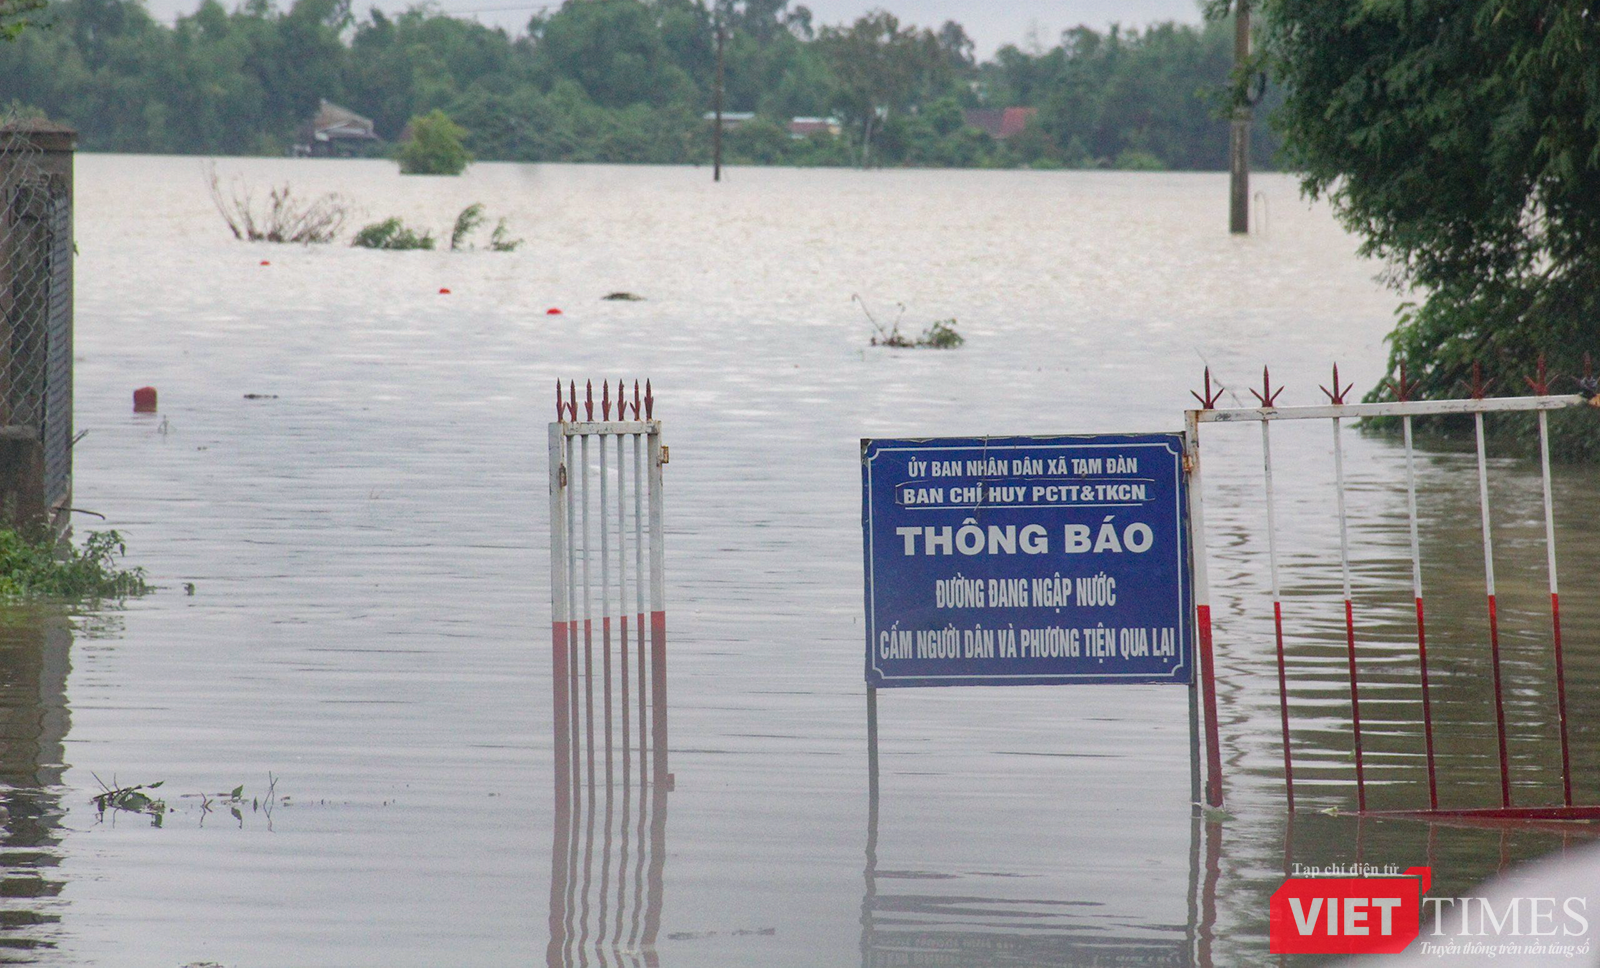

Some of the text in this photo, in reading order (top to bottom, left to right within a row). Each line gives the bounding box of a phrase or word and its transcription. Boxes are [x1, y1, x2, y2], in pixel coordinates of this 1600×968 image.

[908, 457, 926, 477] ỦY
[932, 461, 962, 476] BAN
[967, 457, 1008, 476] NHÂN
[1013, 457, 1043, 475] DÂN
[1048, 456, 1067, 475] XÃ
[1106, 455, 1137, 474] ĐÀN
[903, 482, 1146, 503] BAN CHỈ HUY PCTT&TKCN
[896, 515, 1153, 555] THÔNG BÁO
[936, 571, 1116, 612] ĐƯỜNG ĐANG NGẬP NƯỚC
[880, 621, 1174, 663] CẤM NGƯỜI DÂN VÀ PHƯƠNG TIỆN QUA LẠI
